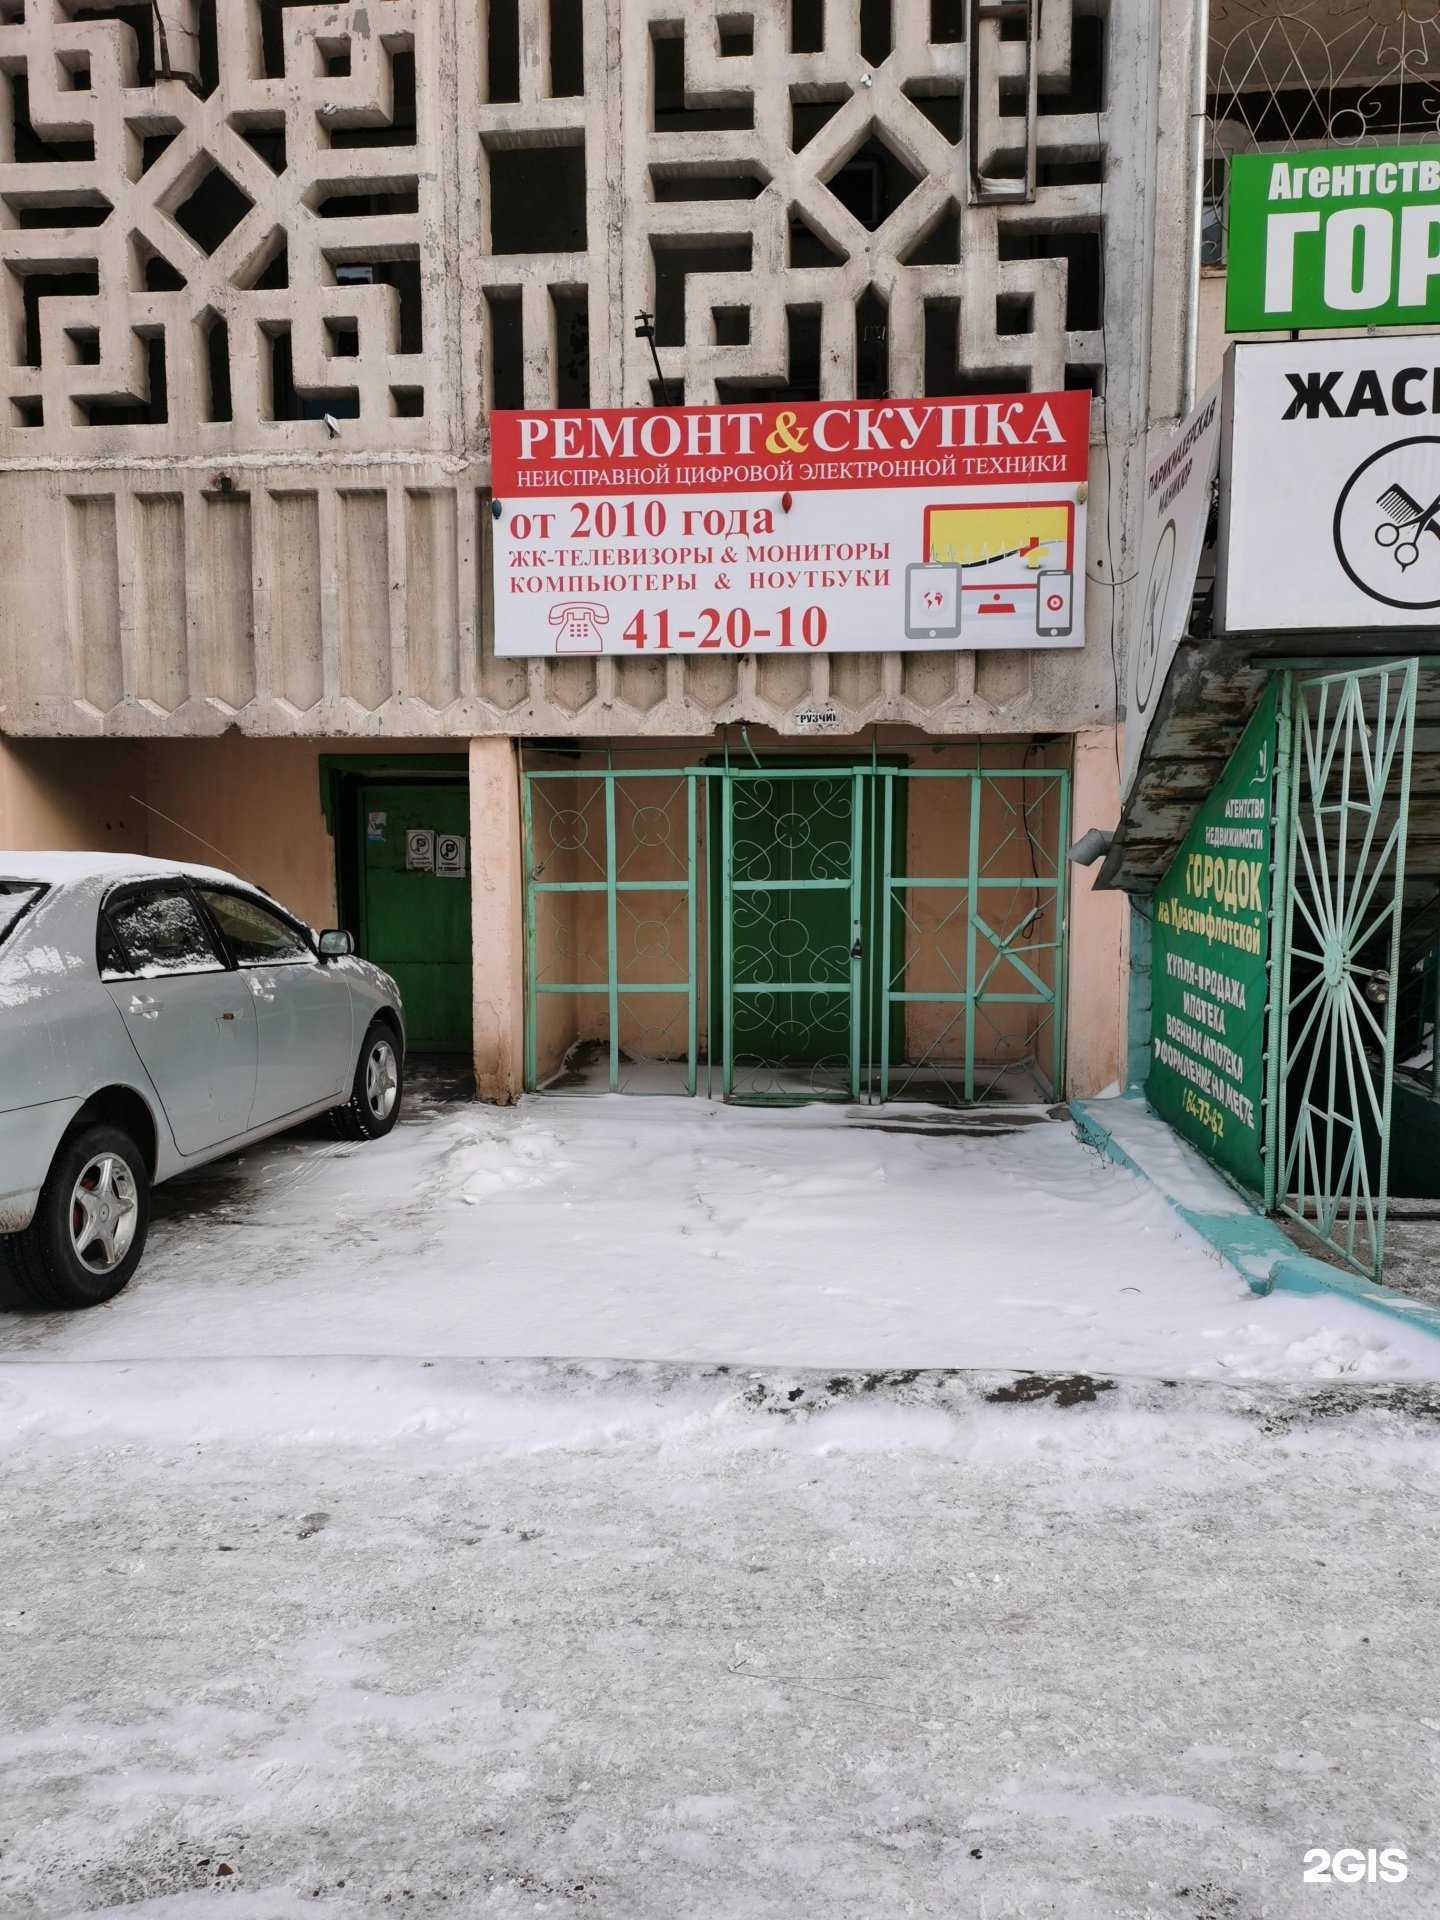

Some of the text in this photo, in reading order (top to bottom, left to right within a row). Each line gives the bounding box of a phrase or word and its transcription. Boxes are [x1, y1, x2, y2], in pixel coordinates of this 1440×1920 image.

[1268, 160, 1440, 200] Агентств
[1264, 204, 1440, 314] ГОР
[1281, 367, 1440, 420] ЖАС
[517, 454, 1067, 488] НЕИСПРАВНОЙ ЦИФРОВОЙ ЭЛЕКТРОННОЙ ТЕХНИКИ
[510, 500, 774, 541] от 2010 года
[508, 542, 890, 568] ЖК-ТЕЛЕВИЗОРЫ & МОНИТОРЫ
[509, 569, 890, 593] КОМПЬЮТЕРЫ & НОУТБУКИ
[622, 605, 828, 649] 41-20-10
[1225, 798, 1265, 819] АГЕНТСТВО
[1206, 826, 1263, 850] НЕДВИЖИМОСТИ
[1186, 853, 1262, 914] ГОРОДОК
[1158, 897, 1261, 955] на Краснофлотской
[1166, 952, 1246, 1011] КУПЛЯ-ПРОДАЖА
[1183, 991, 1226, 1035] ИПОТЕКА
[1166, 1013, 1244, 1083] ВОЕННАЯ ИПОТЕКА
[1225, 1083, 1255, 1130] МЕСТЕ
